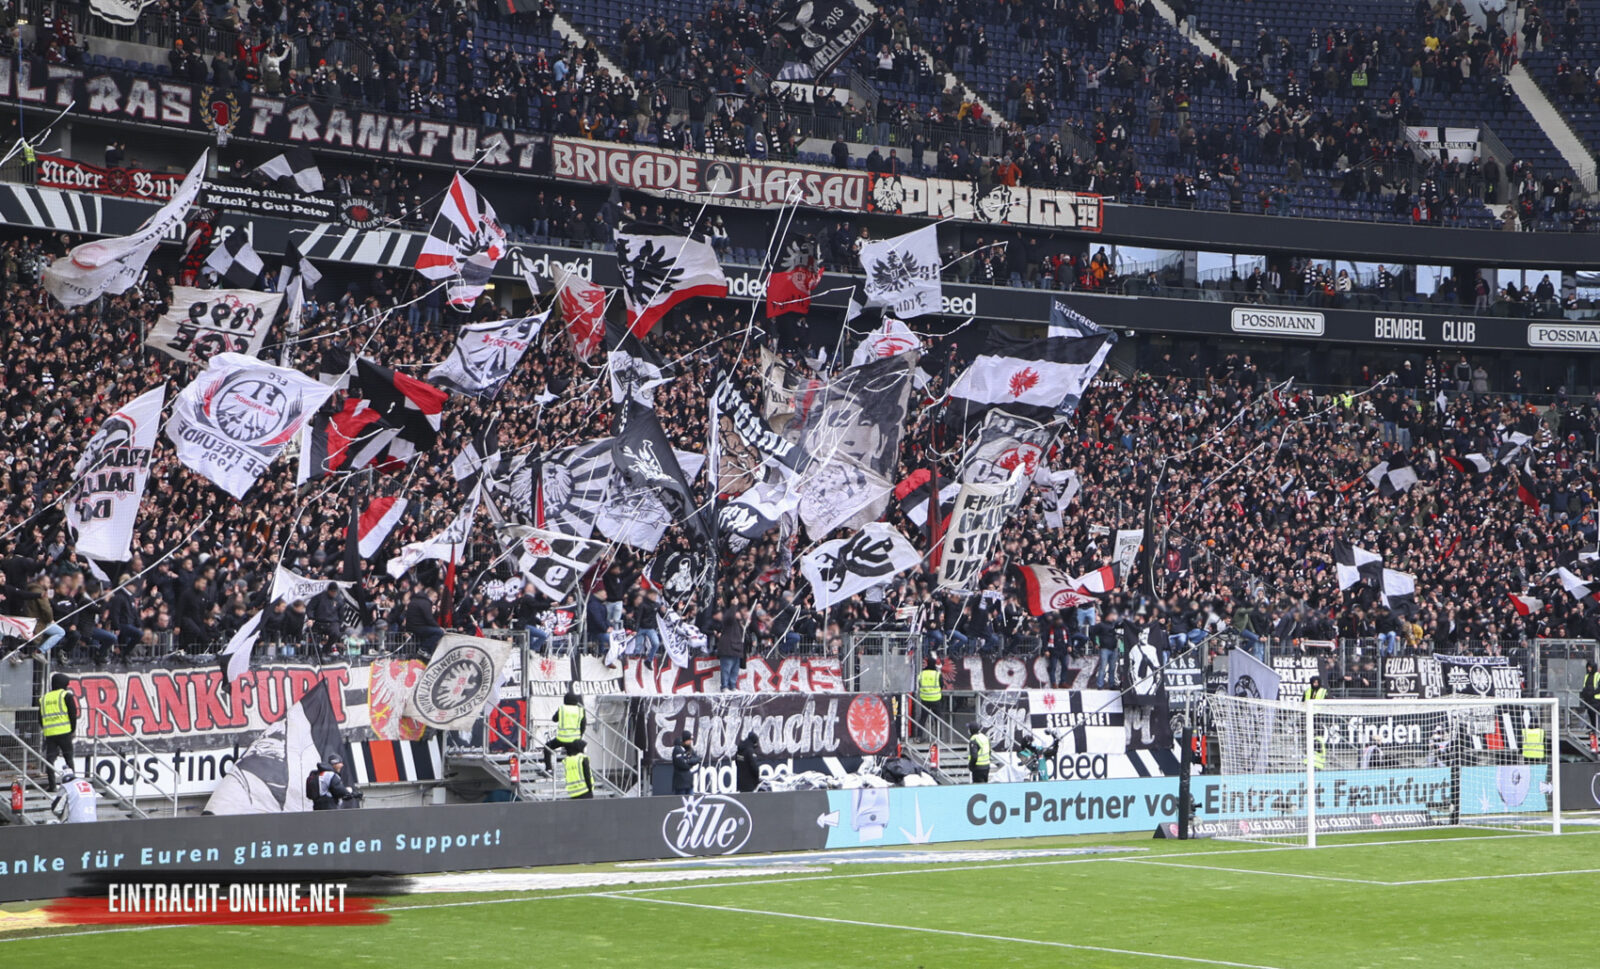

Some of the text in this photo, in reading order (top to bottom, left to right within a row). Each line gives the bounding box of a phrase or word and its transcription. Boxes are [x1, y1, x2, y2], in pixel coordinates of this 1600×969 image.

[251, 97, 544, 169] FRANKFURT
[41, 159, 104, 189] Nieder
[552, 142, 865, 214] BRIGADE NASSAU
[202, 182, 335, 207] Freunde fürs Leben
[262, 201, 290, 213] Gut
[294, 204, 330, 218] Peter
[1077, 204, 1098, 227] 99
[1241, 313, 1316, 330] POSSMANN
[1375, 317, 1476, 343] BEMBEL CLUB
[1385, 658, 1415, 674] FULDA
[531, 679, 622, 695] NUOVA GUARDIA
[1167, 675, 1194, 686] VER
[653, 694, 841, 760] Eintracht
[1347, 717, 1421, 745] finden
[966, 791, 1136, 826] Co-Partner
[1144, 795, 1182, 817] vo
[1333, 777, 1451, 808] Frankfurt
[676, 804, 736, 850] ille
[1249, 822, 1261, 831] LG
[1381, 816, 1393, 825] LG
[82, 850, 124, 868] für
[140, 845, 219, 865] Euren
[234, 836, 382, 865] glänzenden
[396, 829, 502, 853] Support!
